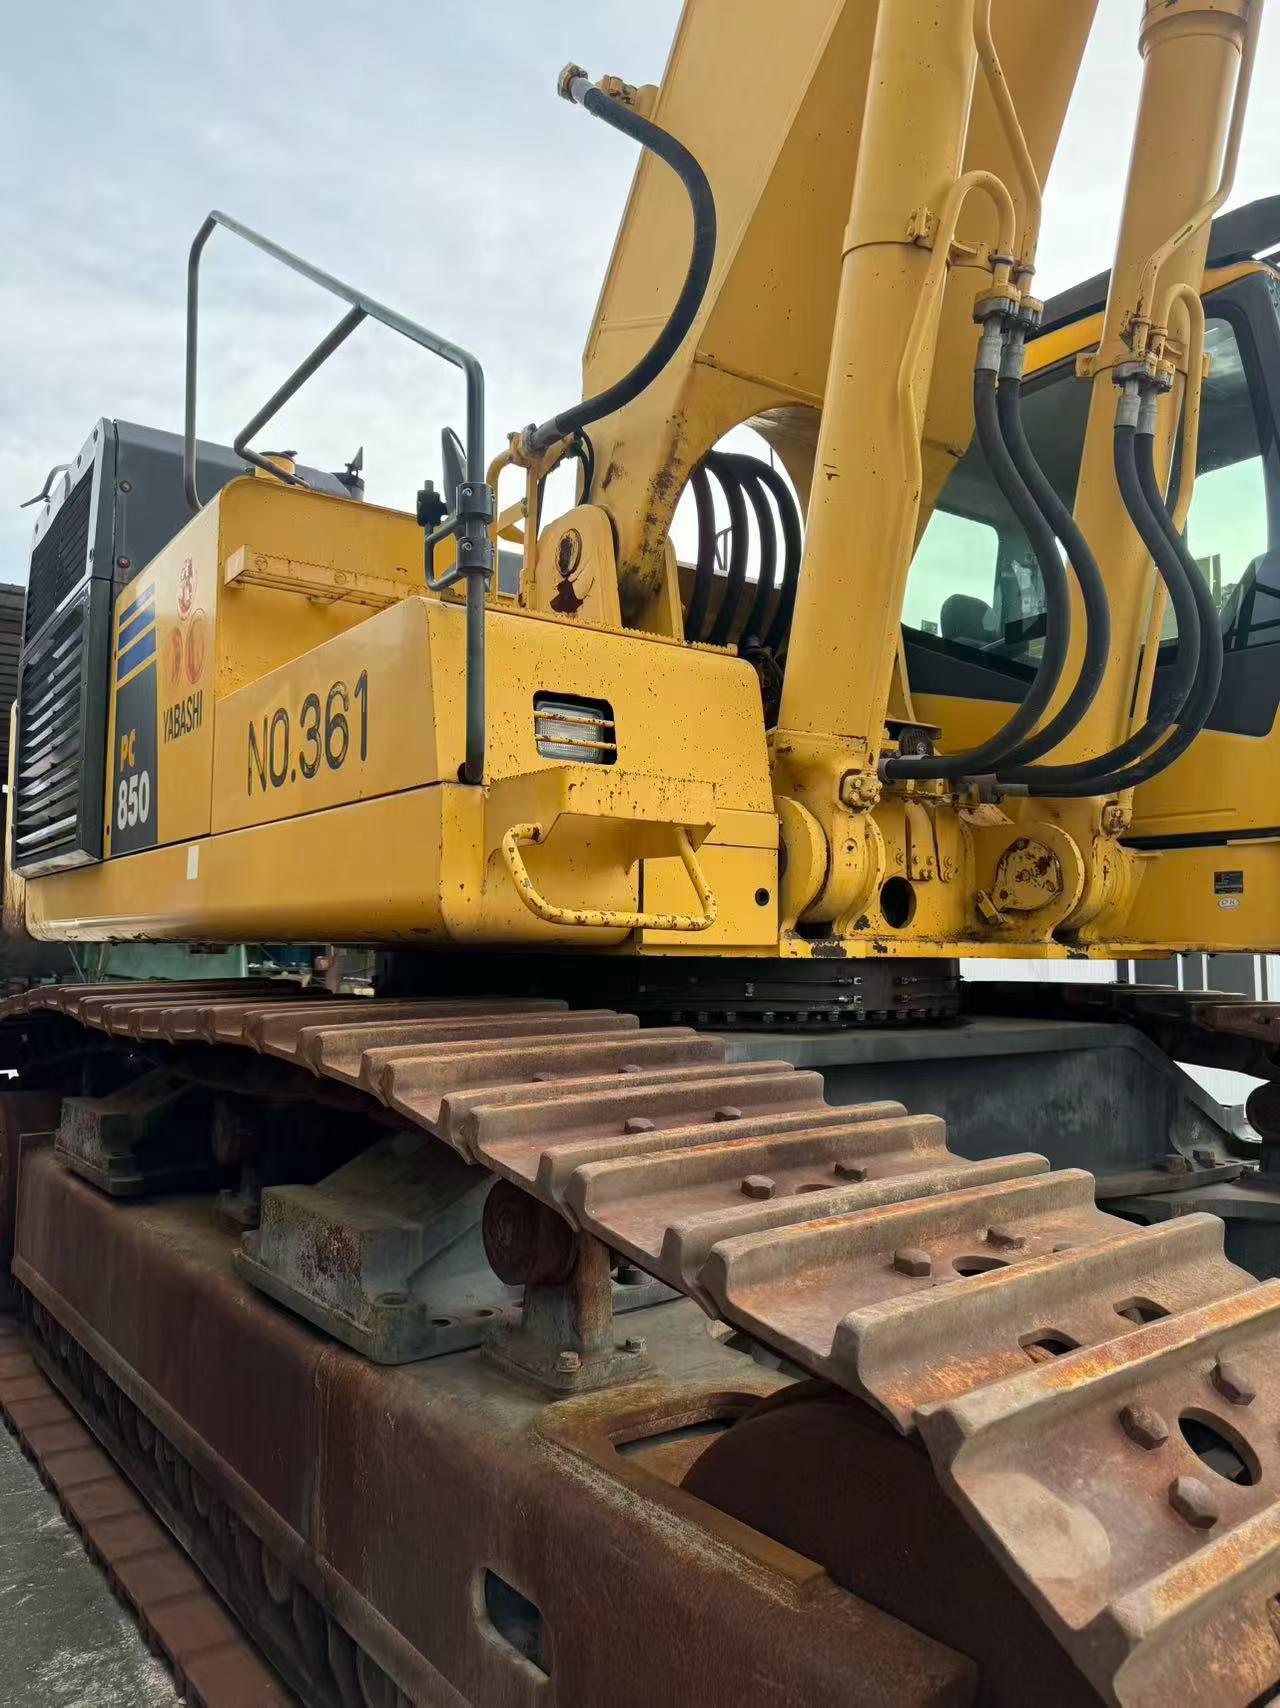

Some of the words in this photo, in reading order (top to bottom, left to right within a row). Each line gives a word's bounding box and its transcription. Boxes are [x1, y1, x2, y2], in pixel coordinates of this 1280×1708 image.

[163, 689, 202, 744] YABASHI
[248, 669, 368, 796] NO.361
[120, 729, 136, 772] PC
[117, 770, 150, 831] 850
